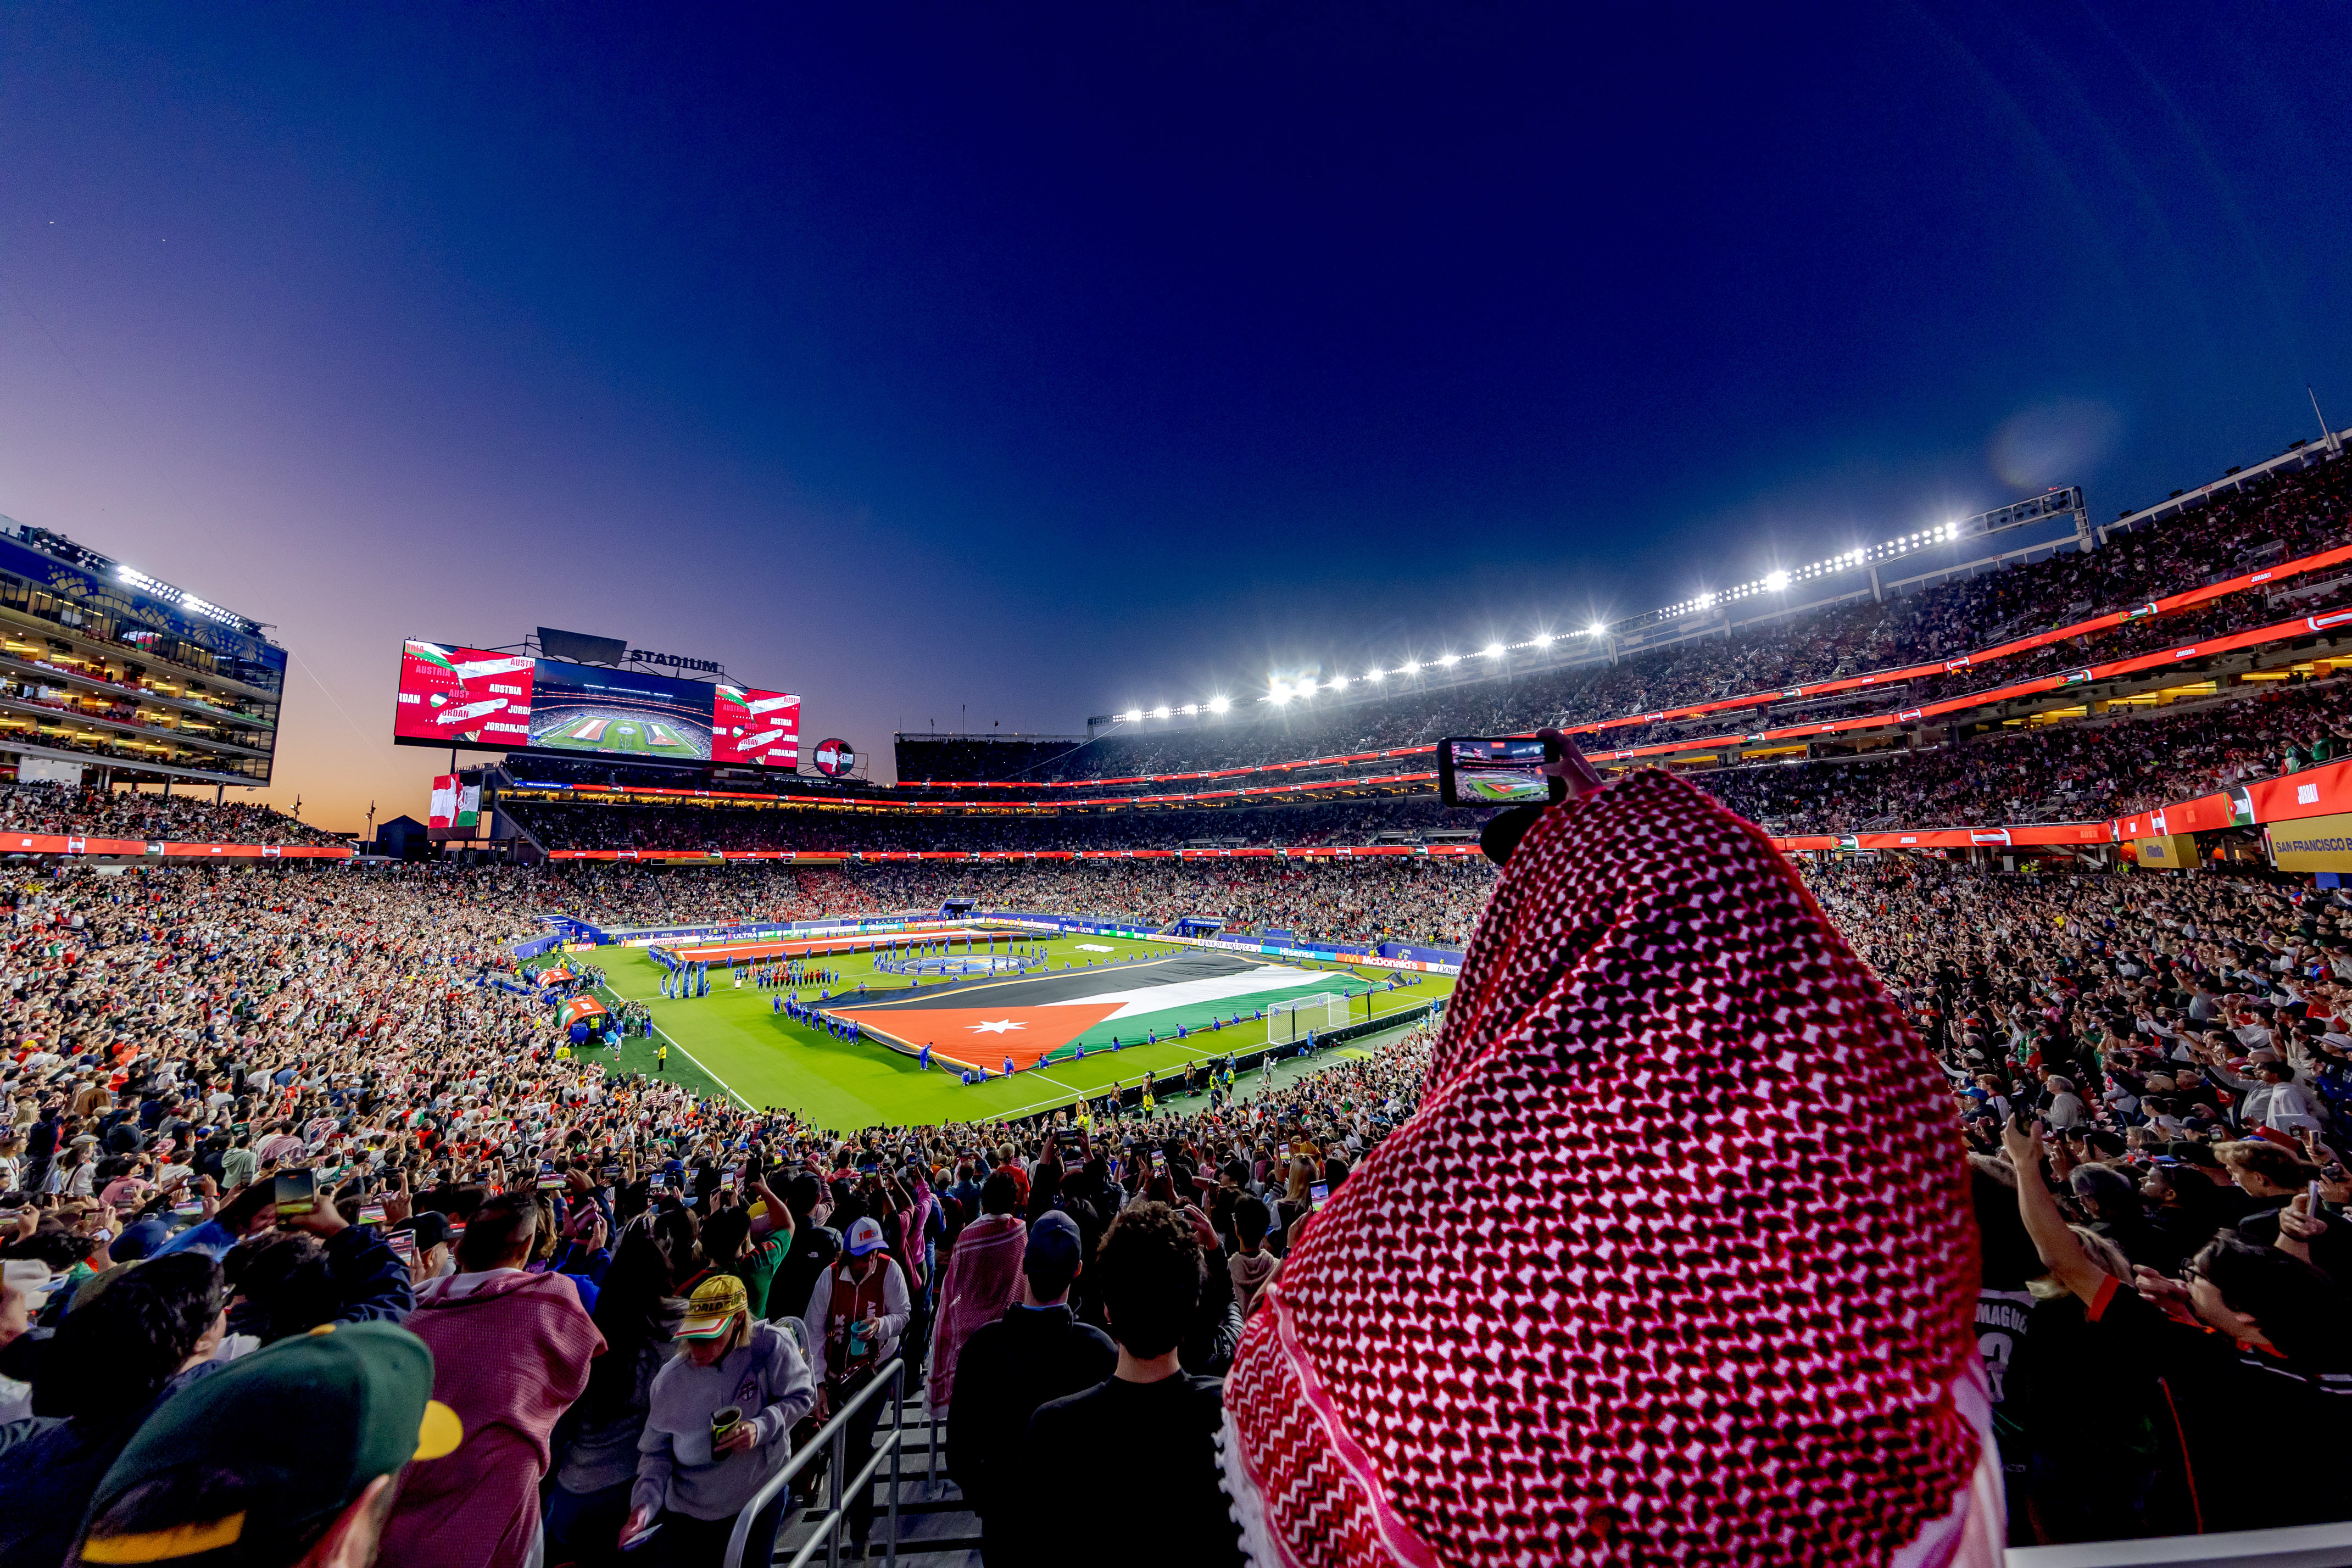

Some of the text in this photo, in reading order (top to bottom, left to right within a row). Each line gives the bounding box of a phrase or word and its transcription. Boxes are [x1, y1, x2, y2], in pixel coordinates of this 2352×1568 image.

[2251, 572, 2272, 582] JORDAN
[2176, 648, 2195, 657] JORDAN
[632, 649, 718, 673] STADIUM
[416, 665, 450, 677] AUSTRIA
[489, 683, 522, 695] AUSTRIA
[723, 704, 745, 713] AUSTRIA
[770, 717, 792, 727] AUSTRIA
[2298, 783, 2319, 805] JORDAN
[2276, 841, 2293, 852] SAN
[2293, 838, 2345, 852] FRANCISCO
[577, 943, 592, 951] Lay's
[1279, 947, 1315, 958] Hisense
[1362, 956, 1418, 970] McDonald's
[1437, 965, 1458, 974] Dove
